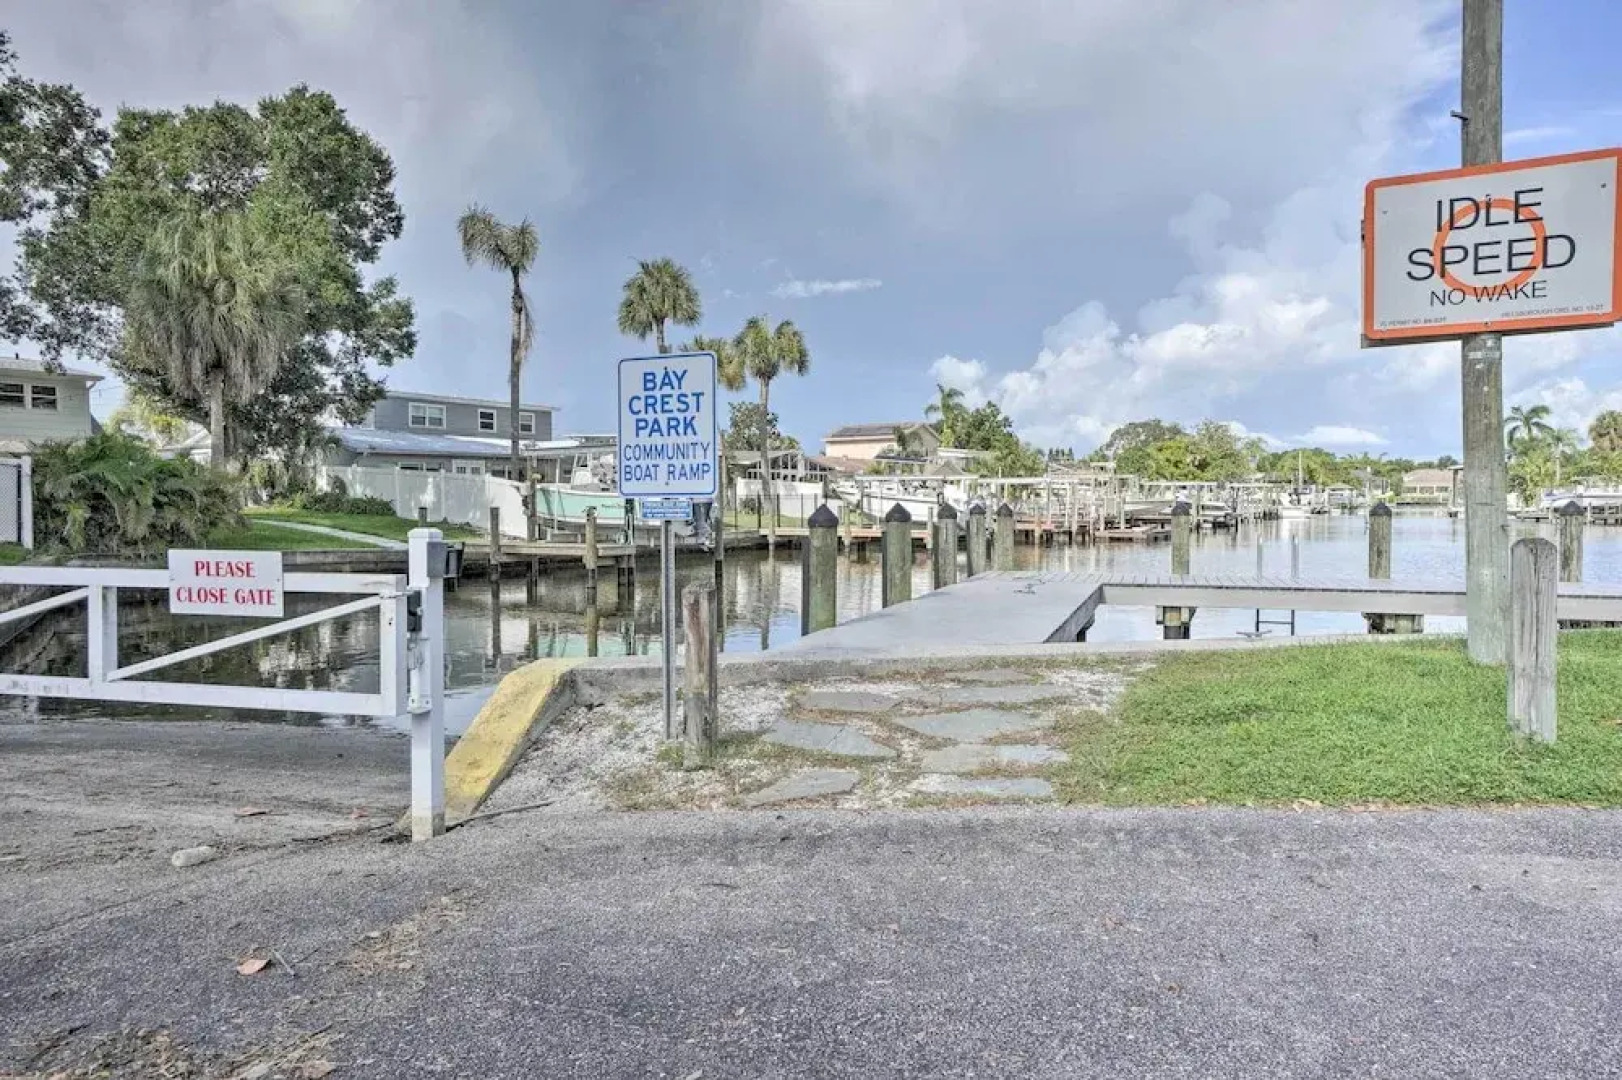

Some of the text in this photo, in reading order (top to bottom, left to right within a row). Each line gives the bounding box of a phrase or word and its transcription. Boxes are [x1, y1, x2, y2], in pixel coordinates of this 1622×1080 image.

[1436, 187, 1544, 232] IDLE
[1406, 234, 1576, 281] SPEED
[1430, 280, 1548, 307] NO WAKE
[643, 369, 688, 392] BAY
[628, 392, 705, 415] CREST
[635, 415, 697, 438] PARK
[624, 441, 710, 461] COMMUNITY
[624, 463, 711, 481] BOAT RAMP
[195, 560, 256, 578] PLEASE
[176, 586, 276, 606] CLOSE GATE
